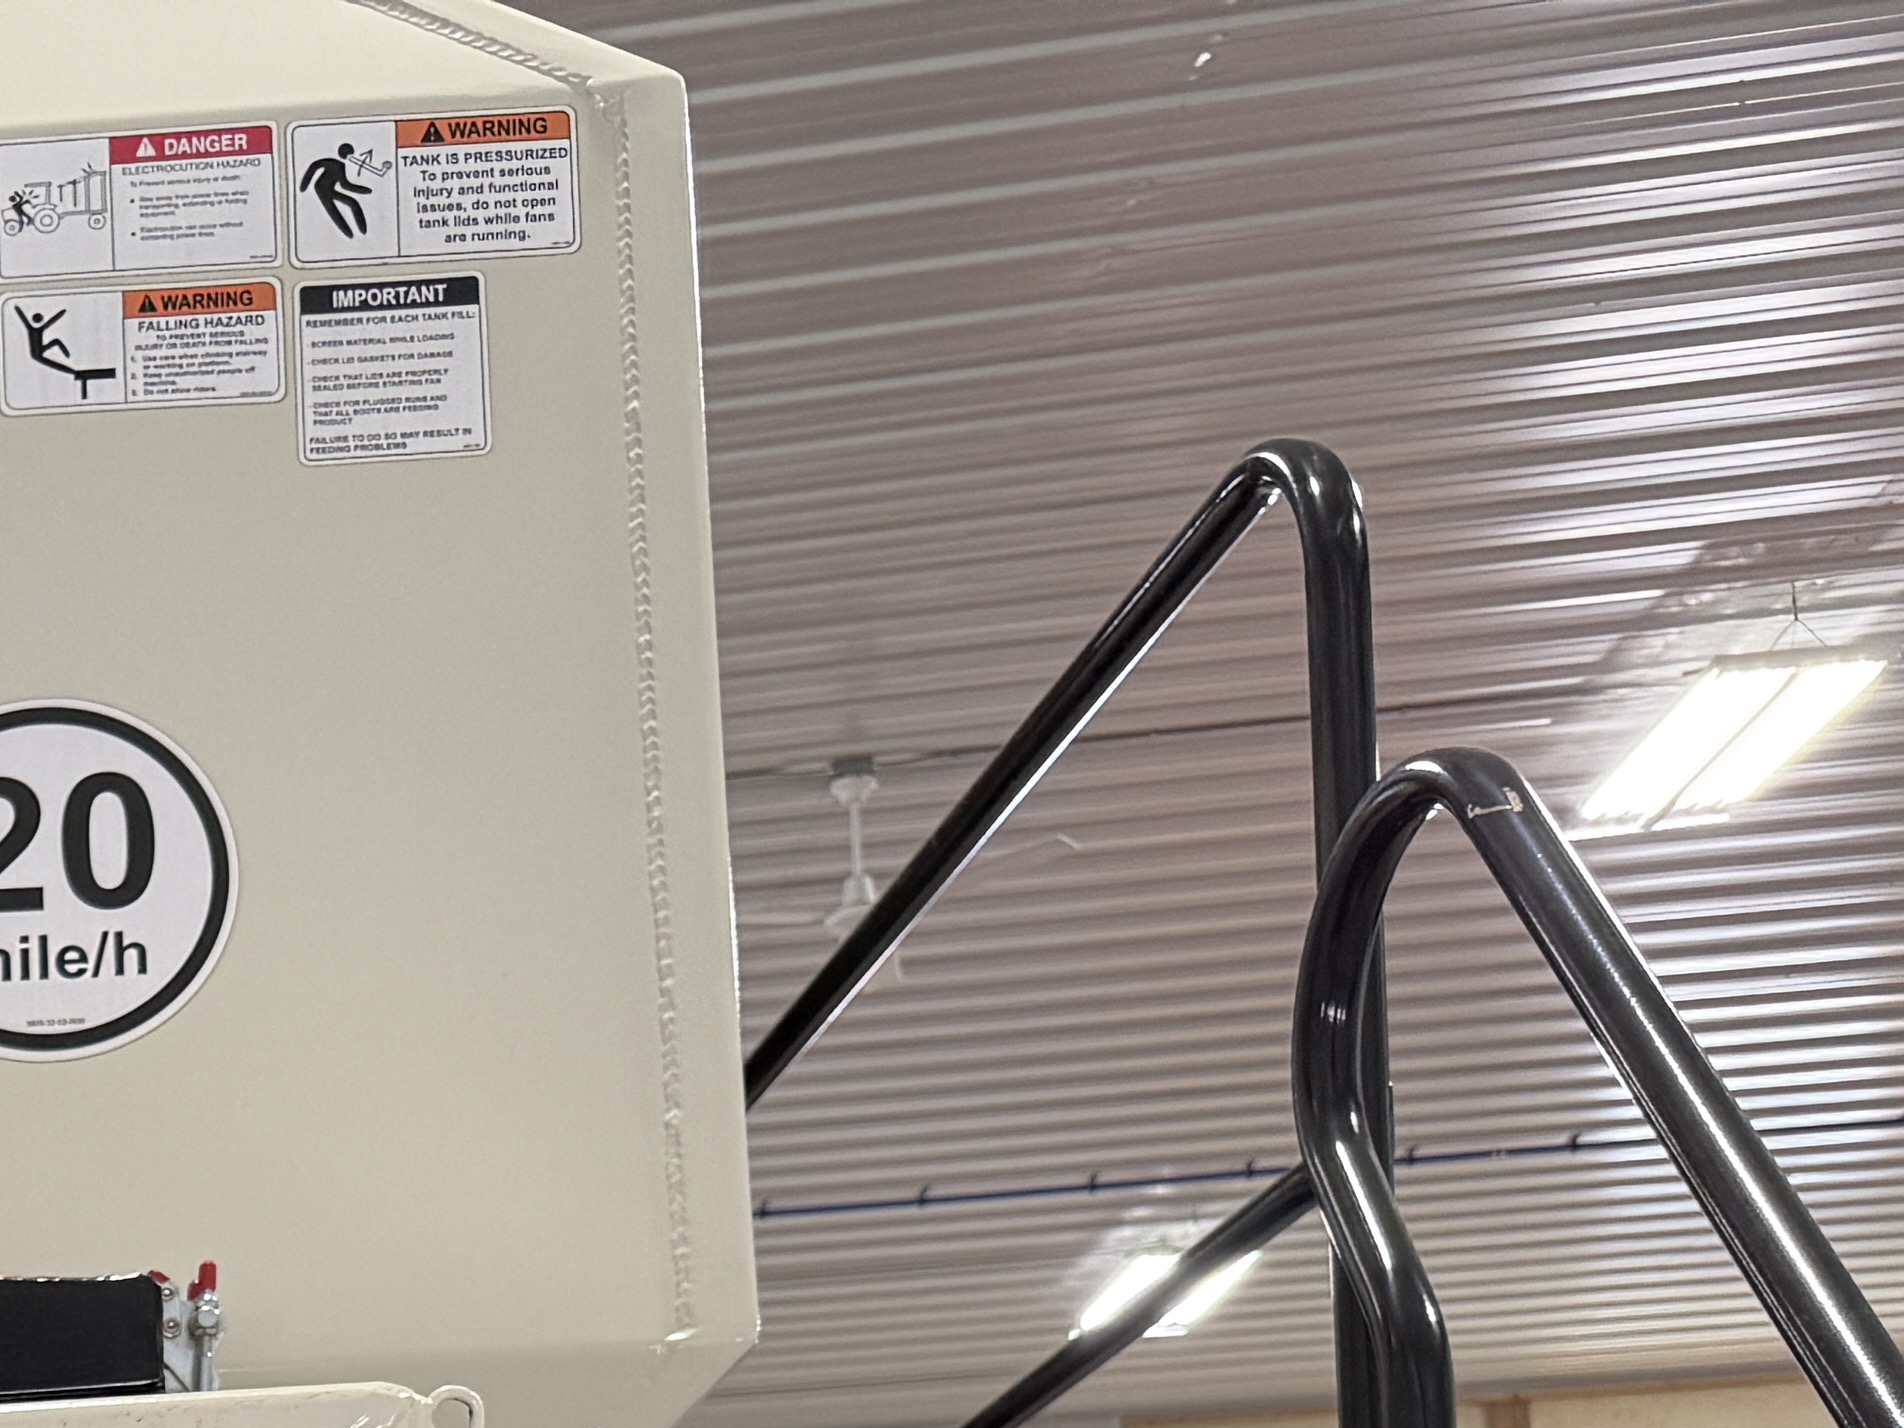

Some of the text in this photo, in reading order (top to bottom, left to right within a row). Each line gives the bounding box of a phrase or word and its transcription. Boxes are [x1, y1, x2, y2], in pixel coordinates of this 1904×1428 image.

[448, 118, 547, 139] WARNING
[164, 134, 247, 155] DANGER
[401, 148, 567, 166] TANK IS PRESSURIZED
[122, 158, 261, 175] ELECTROCUTION HAZARD
[421, 166, 551, 182] To prevent serious
[414, 179, 558, 200] injury and functional
[417, 197, 556, 213] issues, do not open
[419, 212, 555, 229] tank lids while fans
[445, 229, 530, 243] are running.
[161, 290, 253, 311] WARNING
[333, 284, 447, 308] IMPORTANT
[138, 315, 264, 332] FALLING HAZARD
[306, 317, 363, 328] REMEMBER
[392, 315, 418, 323] EACH
[422, 313, 448, 322] TANK
